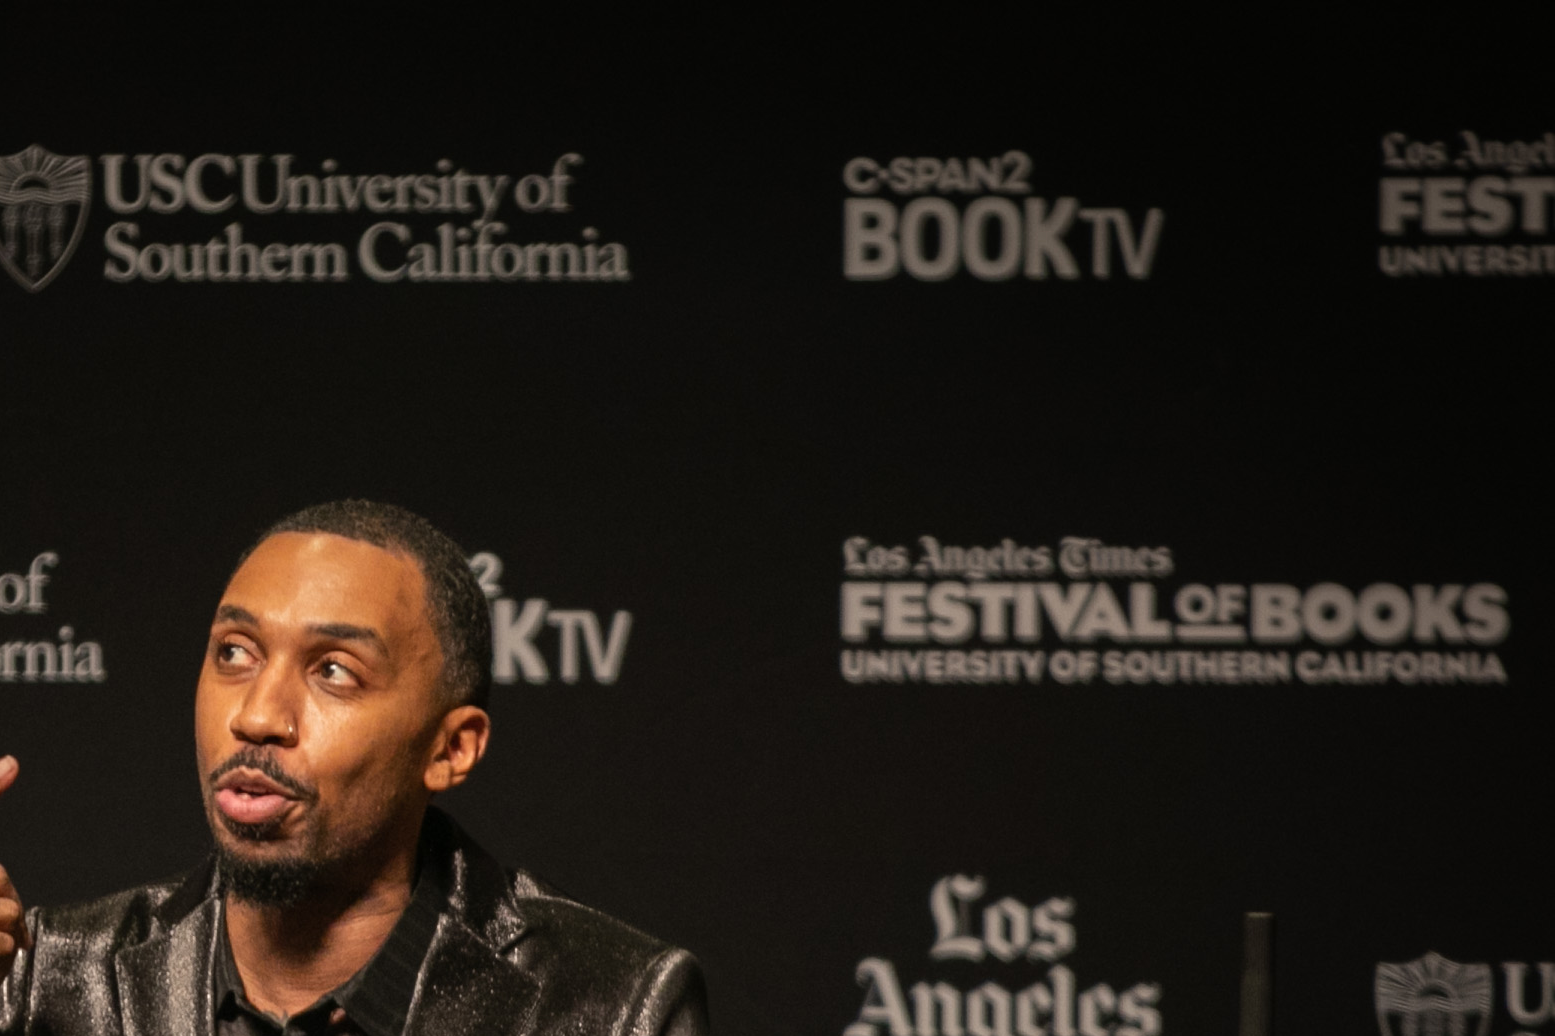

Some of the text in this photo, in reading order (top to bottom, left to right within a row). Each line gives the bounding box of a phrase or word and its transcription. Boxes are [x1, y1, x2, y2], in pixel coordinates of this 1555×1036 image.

[1382, 131, 1449, 170] Los
[101, 152, 585, 224] USC University of
[103, 217, 632, 283] Southern California
[841, 535, 1175, 580] Los Angeles Times
[840, 581, 1511, 646] FESTIVAL OF BOOKS
[840, 649, 1508, 686] UNIVERSITY OF SOUTHERN CALIFORNIA
[929, 873, 1078, 962] Los
